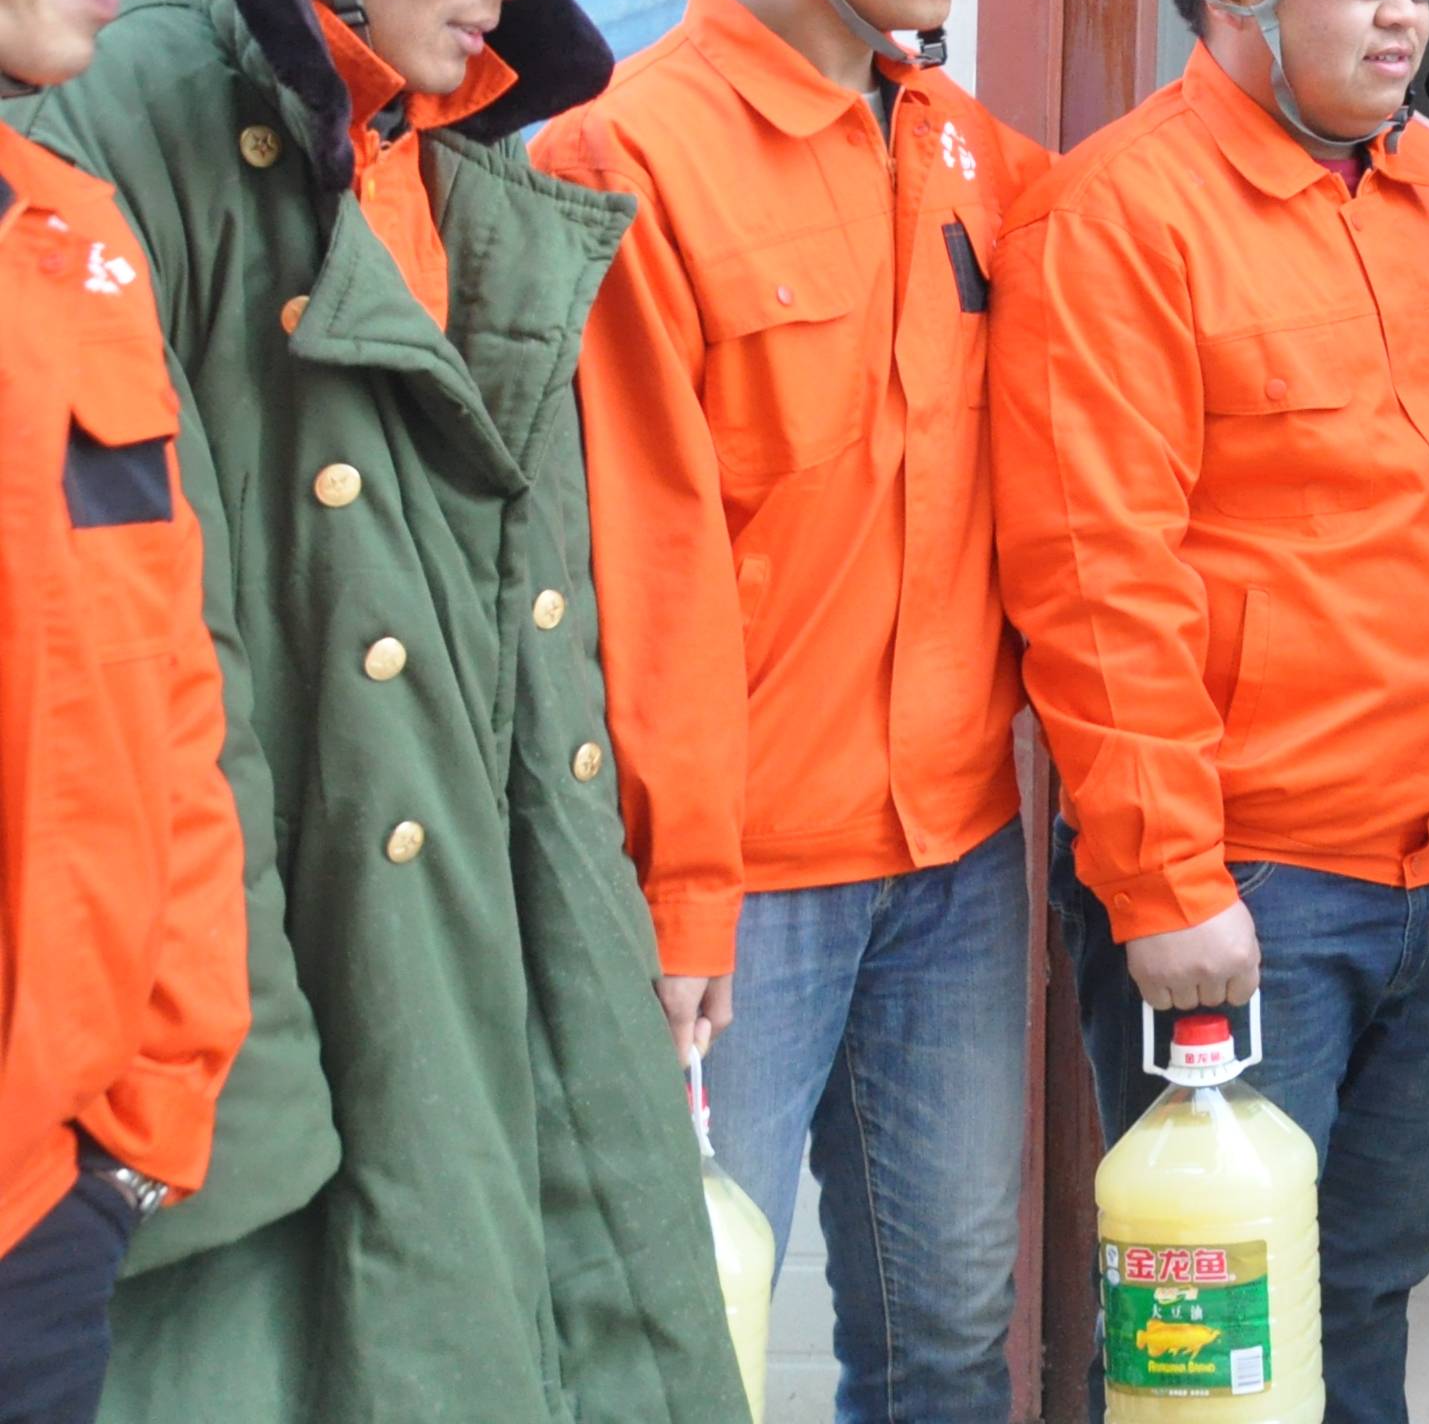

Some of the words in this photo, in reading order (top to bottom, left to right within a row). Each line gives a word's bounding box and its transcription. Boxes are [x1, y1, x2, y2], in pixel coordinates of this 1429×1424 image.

[1125, 1247, 1229, 1282] 金龙鱼
[1152, 1304, 1203, 1321] 大豆油
